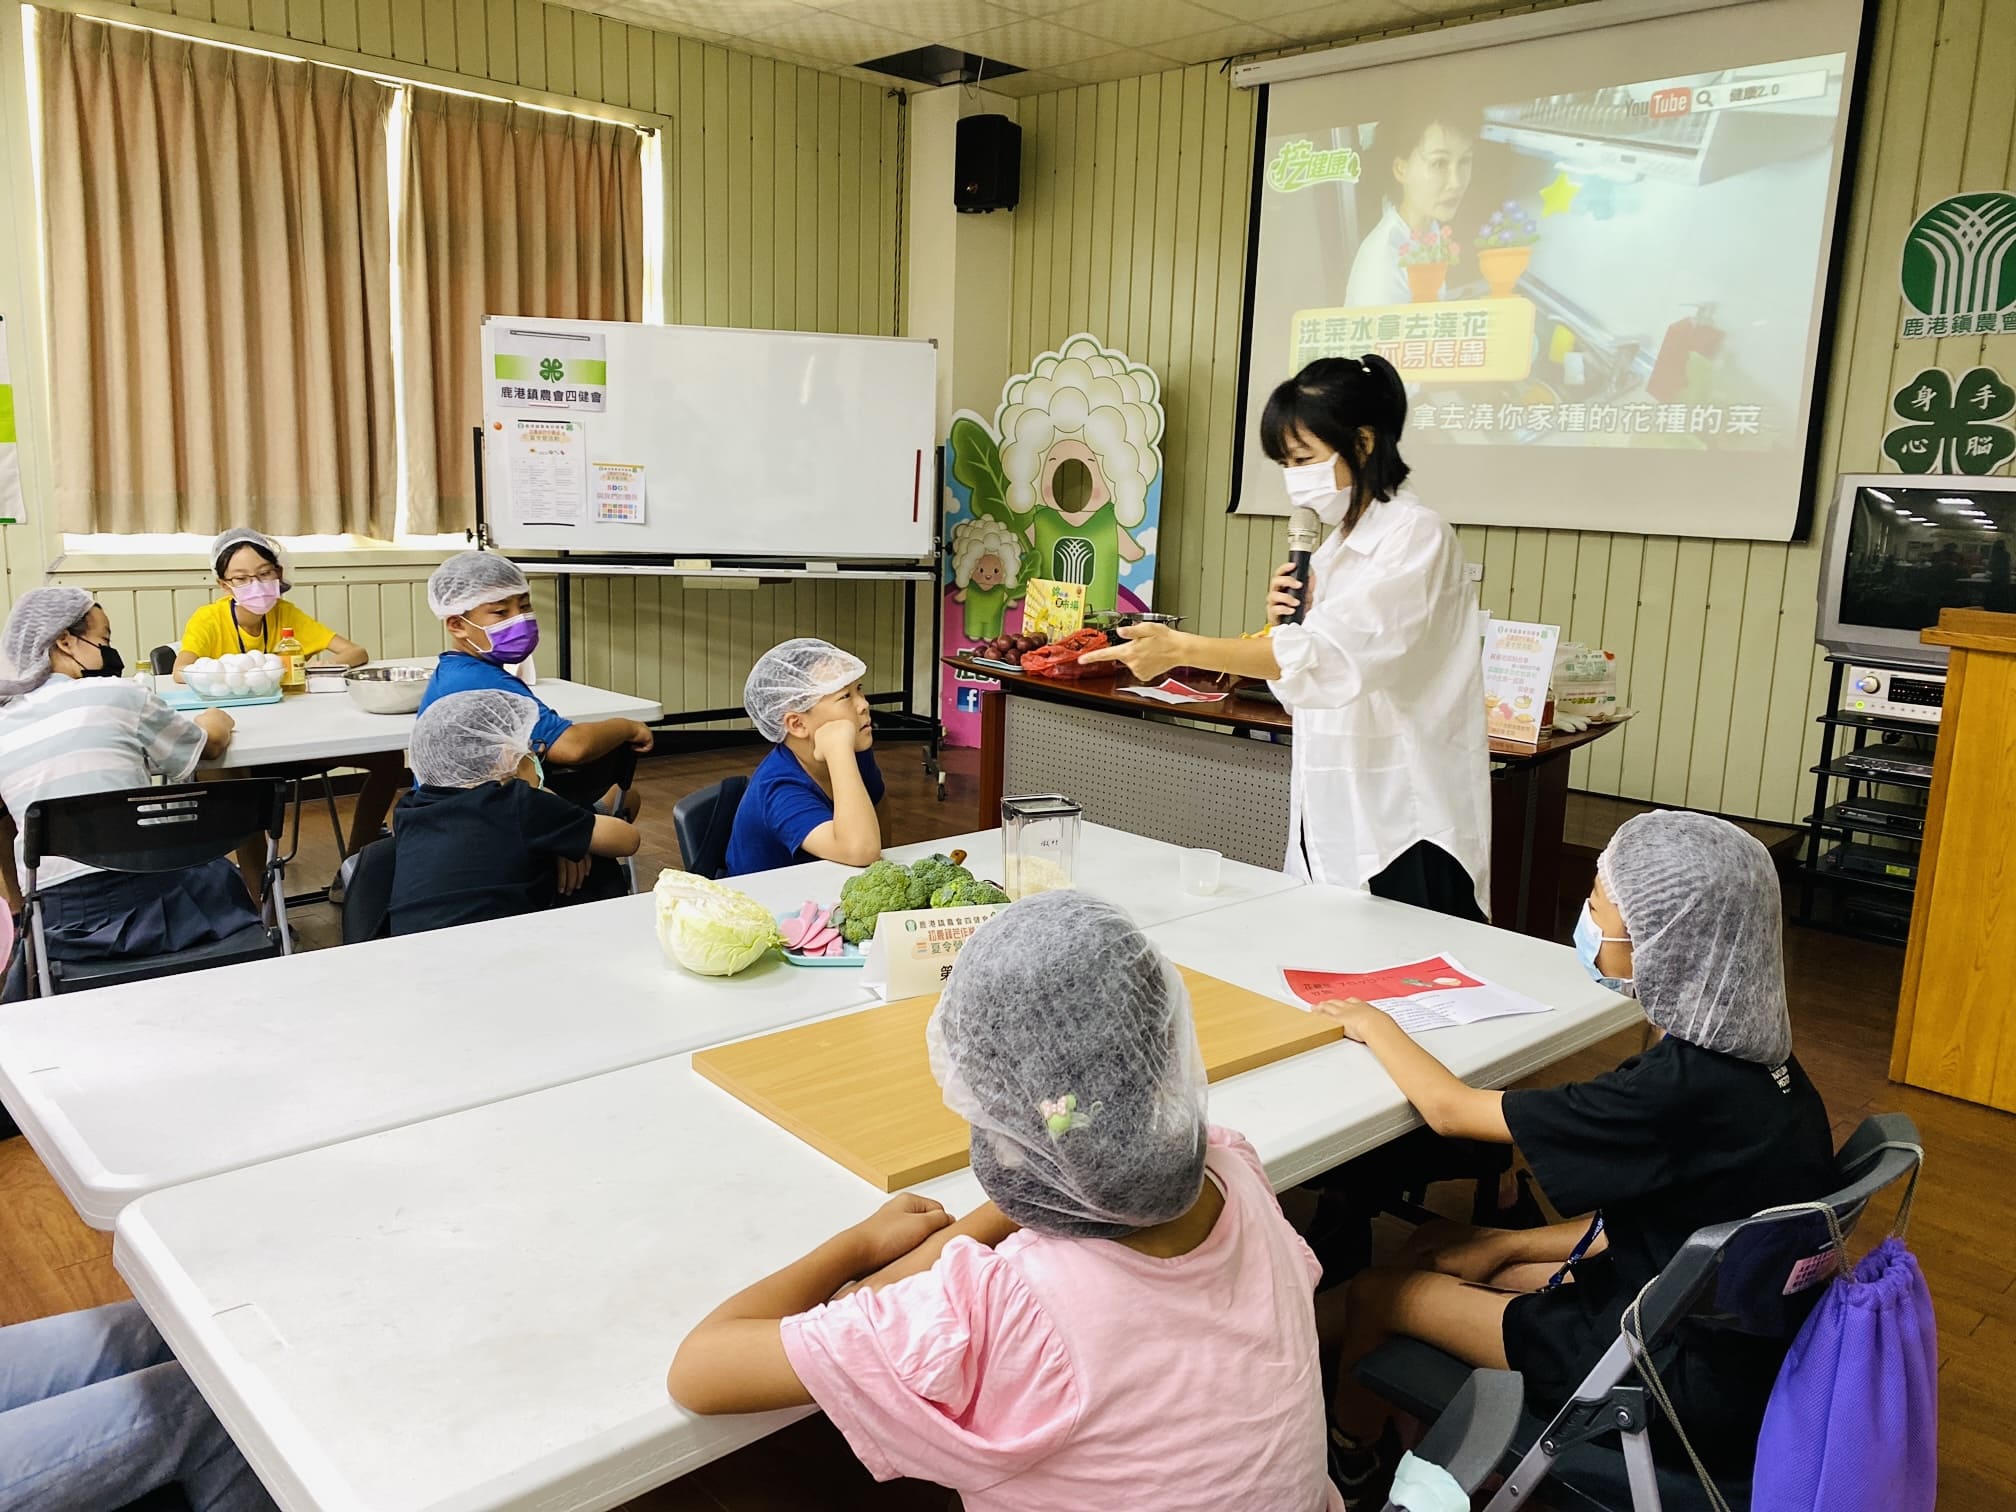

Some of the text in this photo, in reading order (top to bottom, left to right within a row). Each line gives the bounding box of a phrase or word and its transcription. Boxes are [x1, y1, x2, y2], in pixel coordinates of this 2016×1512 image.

[1625, 90, 1688, 118] YouTube
[1299, 311, 1488, 344] 洗菜水拿去澆花
[1903, 311, 2016, 336] 鹿港鎮農會
[501, 386, 602, 403] 鹿港鎮農會四健會
[1911, 385, 1937, 411] 身
[1969, 384, 1996, 410] 手
[1412, 403, 1762, 434] 拿去澆你家種的花種的菜
[1901, 438, 1929, 454] 心
